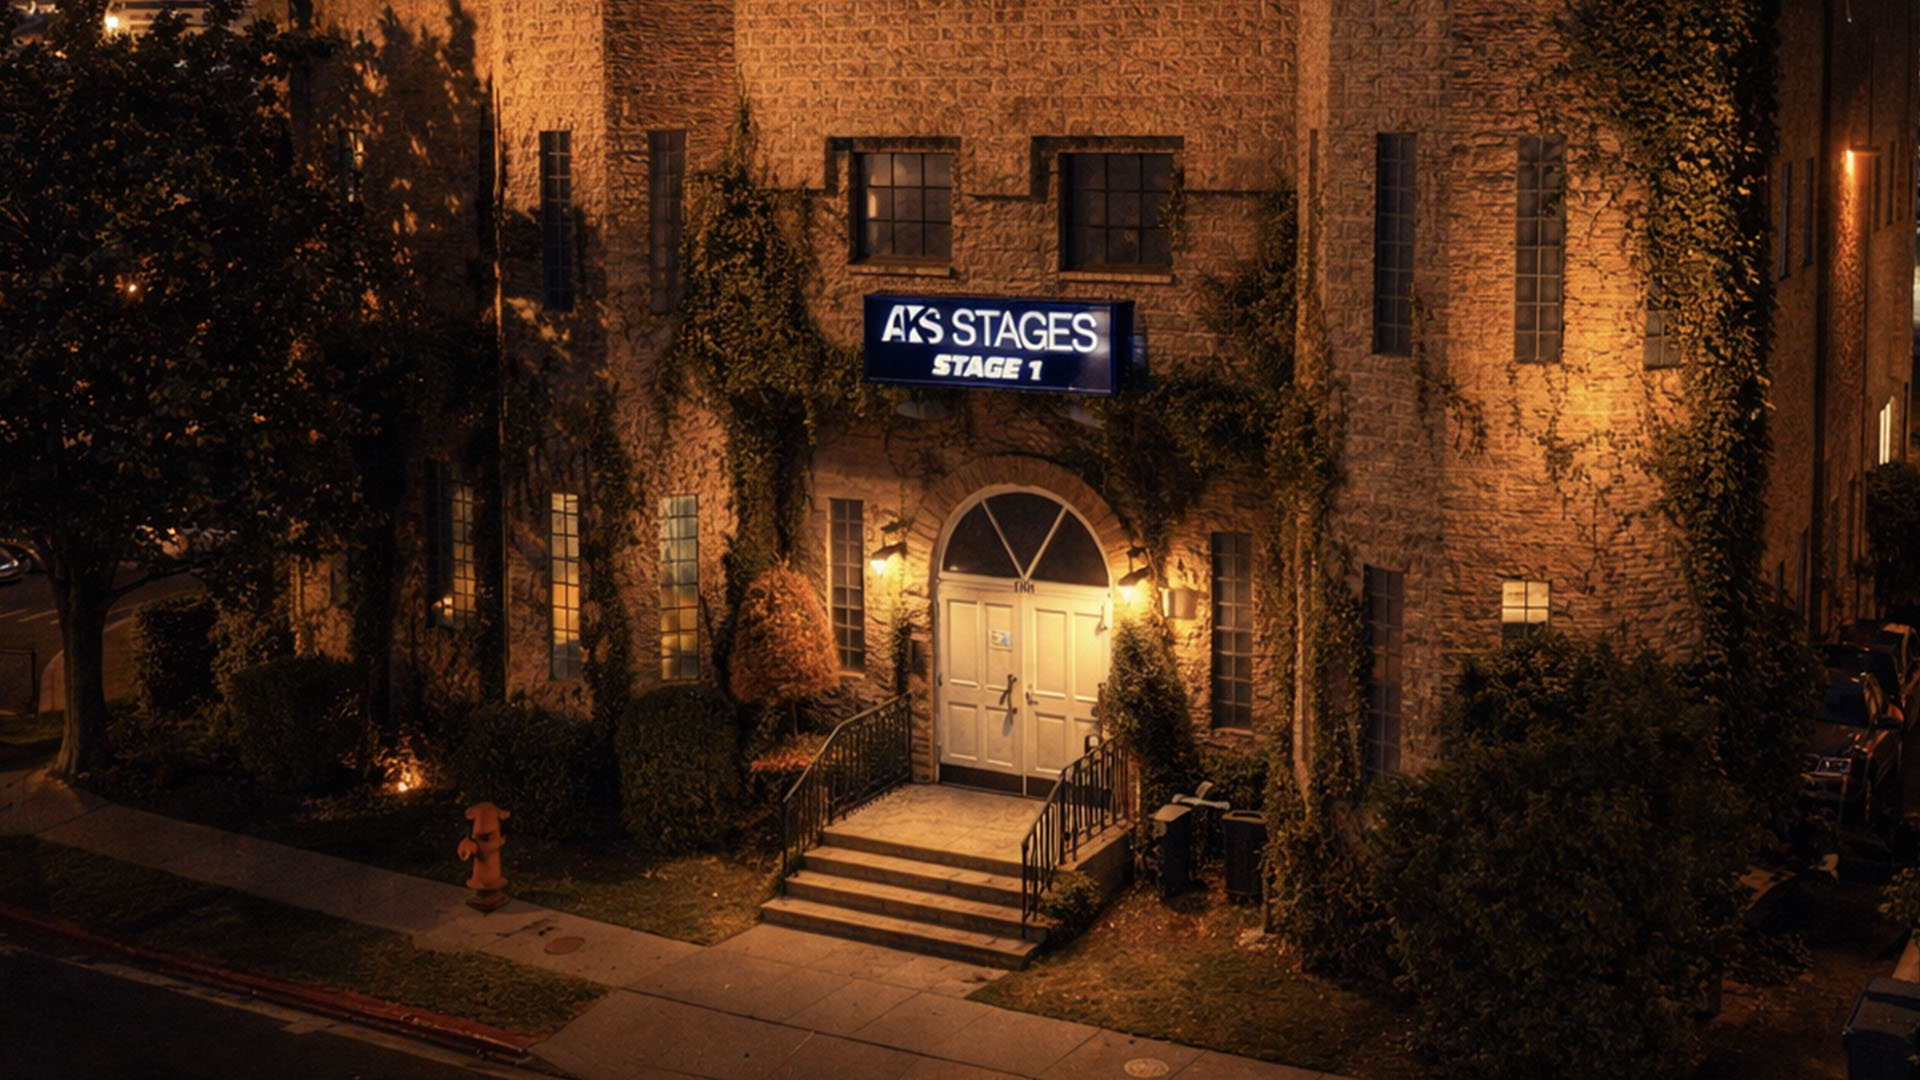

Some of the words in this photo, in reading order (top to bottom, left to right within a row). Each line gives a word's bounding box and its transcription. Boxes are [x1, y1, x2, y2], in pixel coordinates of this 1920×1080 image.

[881, 305, 944, 344] AKS
[952, 308, 1098, 353] STAGES
[932, 354, 1022, 379] STAGE
[1028, 360, 1043, 381] 1
